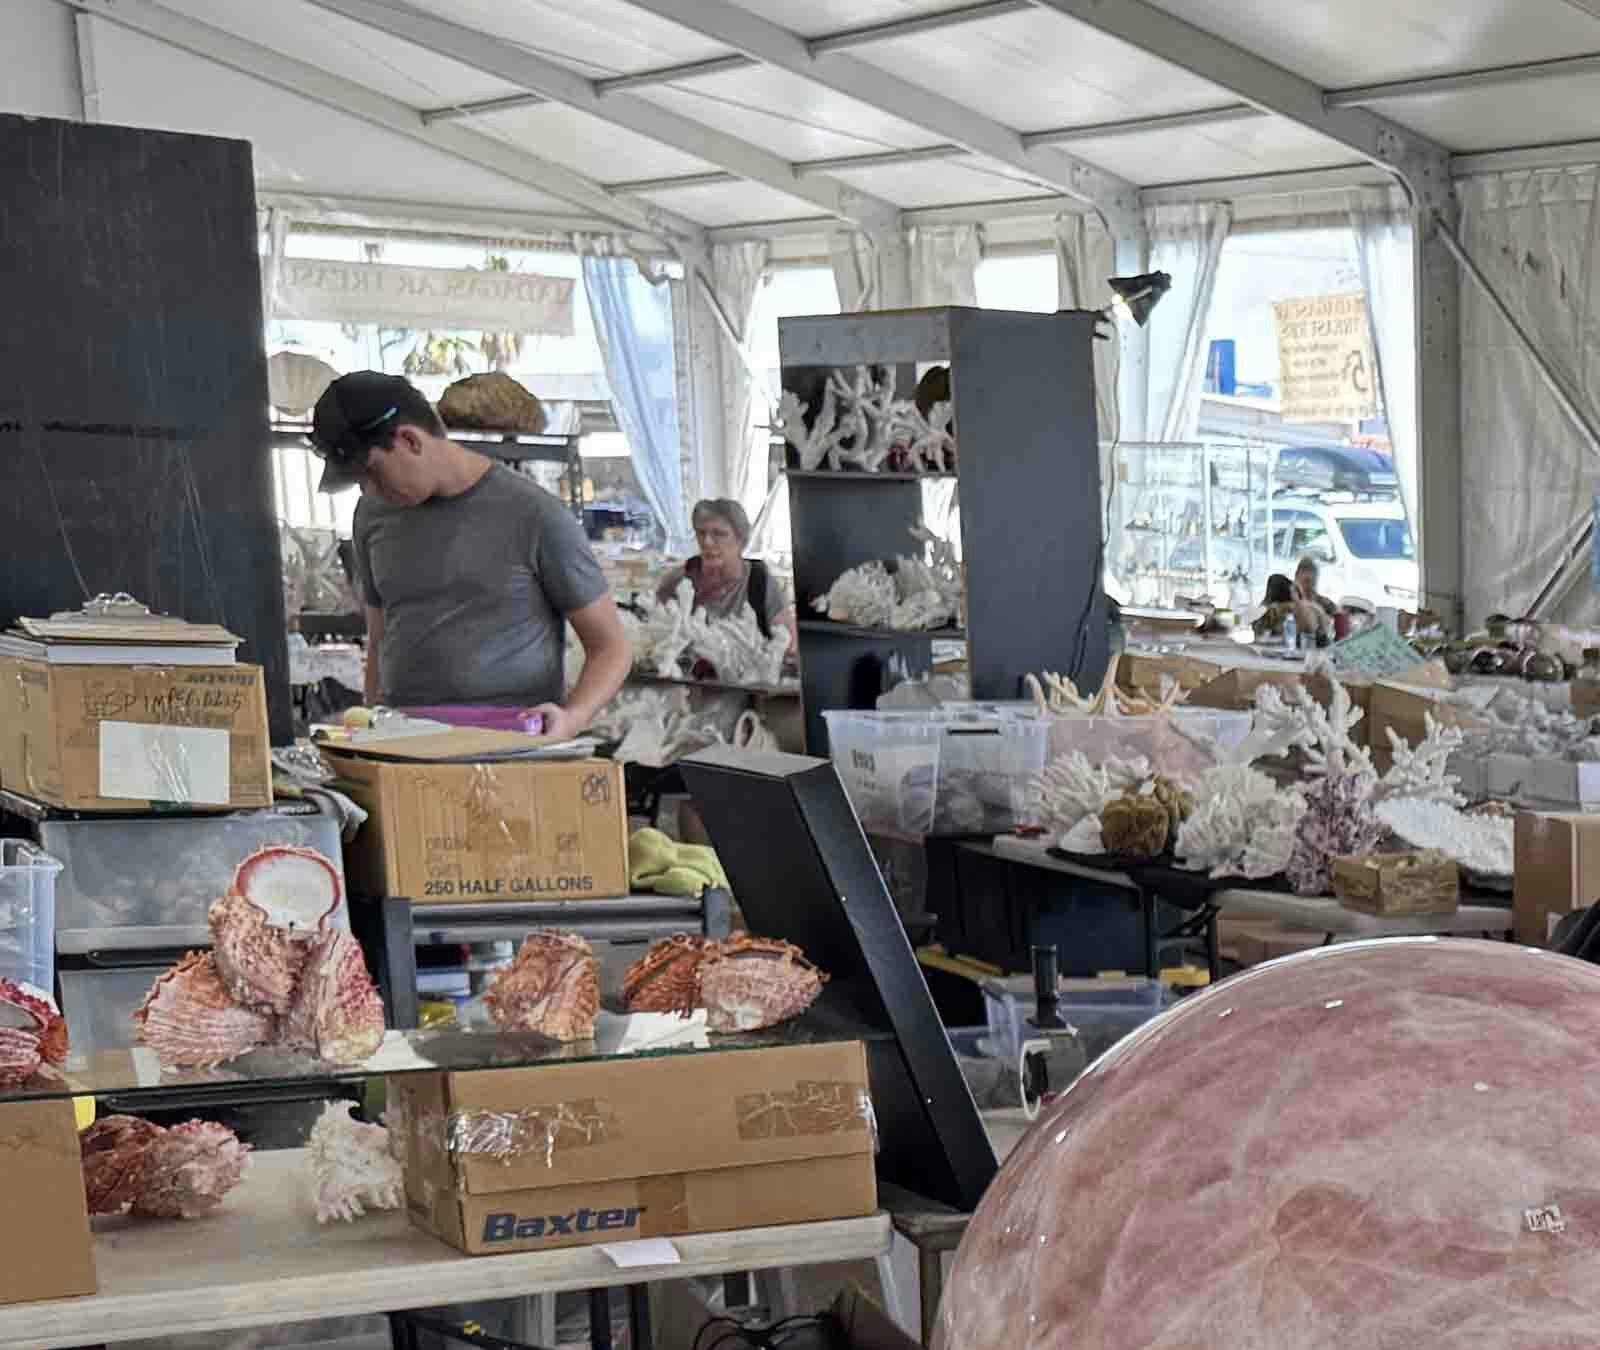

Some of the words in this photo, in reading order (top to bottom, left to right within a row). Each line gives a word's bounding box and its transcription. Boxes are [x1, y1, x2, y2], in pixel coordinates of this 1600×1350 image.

[424, 879, 454, 896] 250
[459, 878, 505, 895] HALF
[510, 875, 593, 893] GALLONS
[482, 1206, 647, 1243] Baxter
